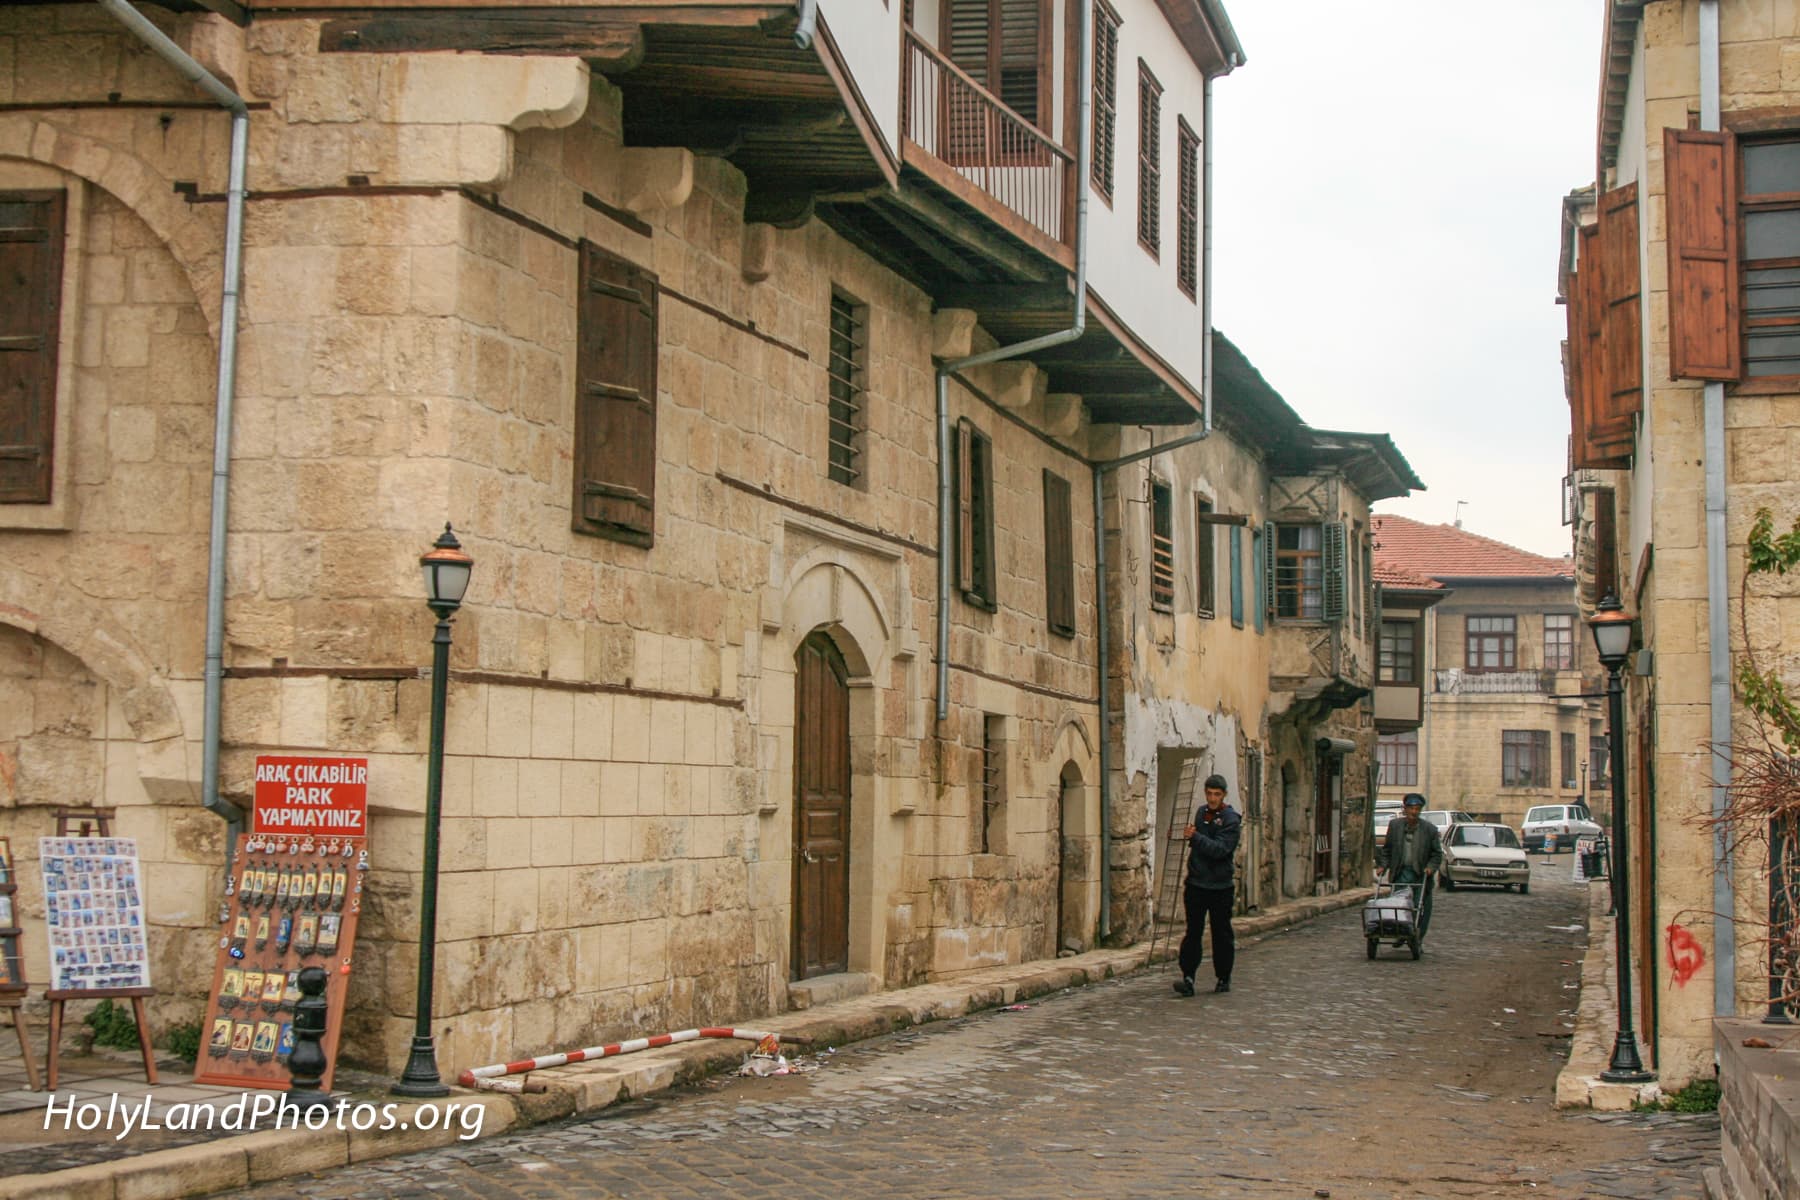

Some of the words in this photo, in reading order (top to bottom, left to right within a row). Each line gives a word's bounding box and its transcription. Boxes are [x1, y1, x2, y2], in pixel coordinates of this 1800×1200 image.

[256, 764, 292, 786] ARAÇ
[294, 762, 367, 786] ÇIKABİLİR
[285, 786, 334, 805] PARK
[258, 807, 362, 828] YAPMAYINIZ
